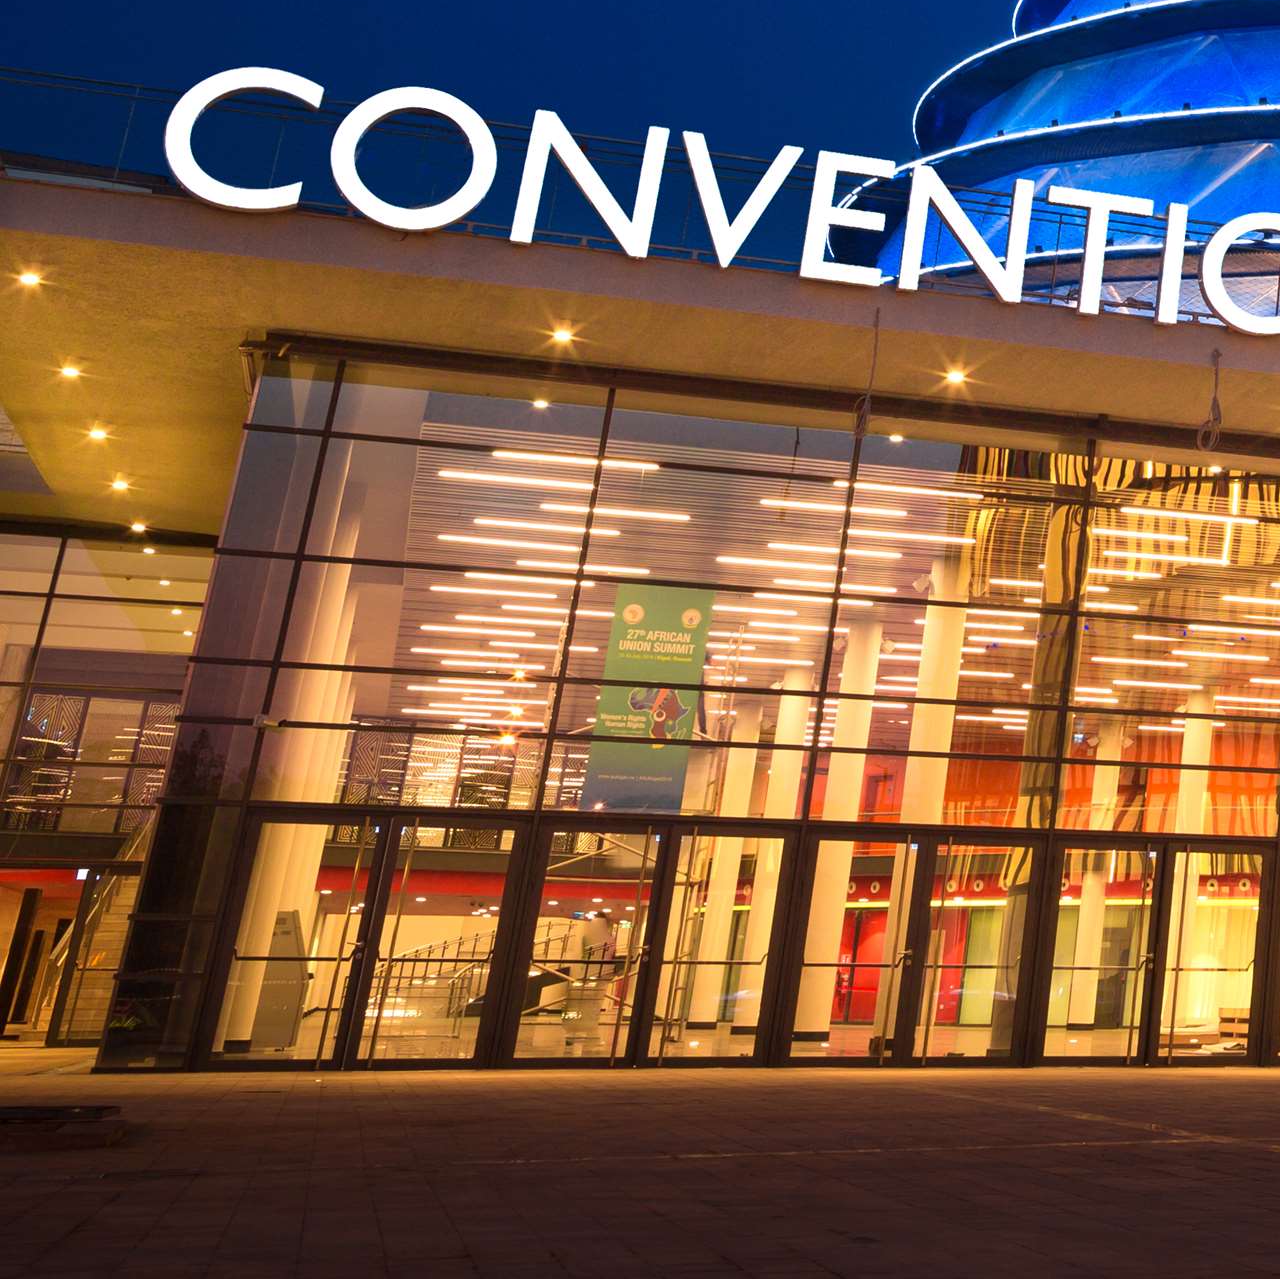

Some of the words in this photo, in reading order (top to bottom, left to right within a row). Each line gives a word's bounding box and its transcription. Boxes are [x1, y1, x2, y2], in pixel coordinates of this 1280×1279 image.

[647, 630, 692, 643] AFRICAN
[618, 640, 651, 652] UNION
[653, 642, 696, 655] SUMMIT
